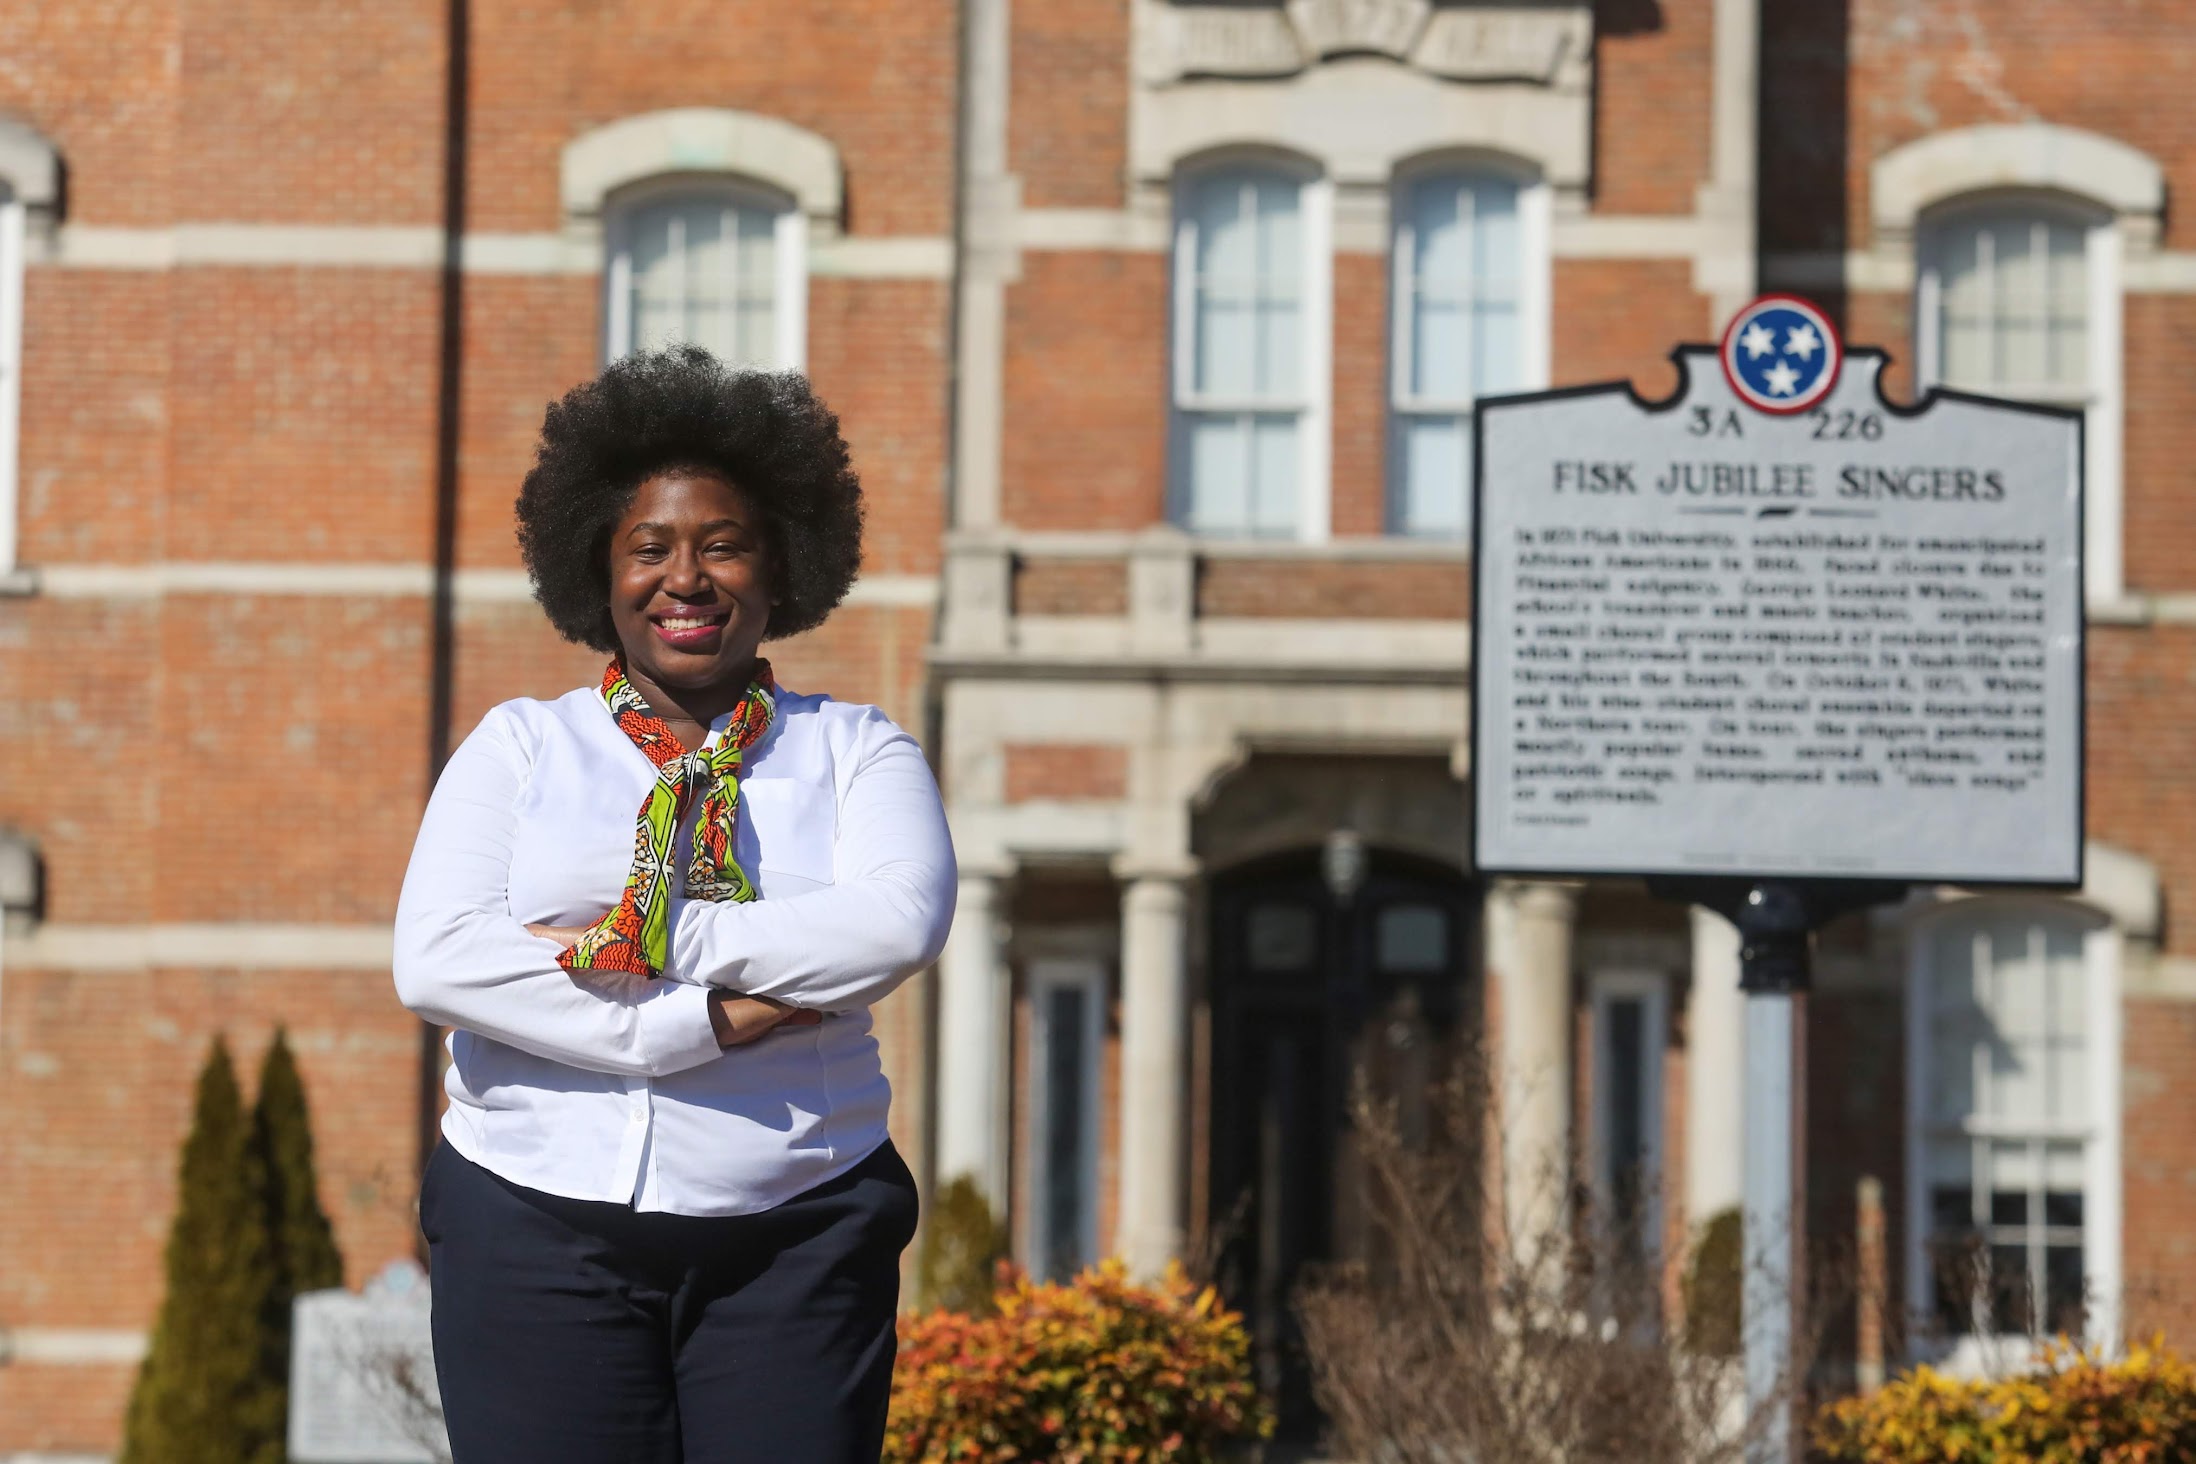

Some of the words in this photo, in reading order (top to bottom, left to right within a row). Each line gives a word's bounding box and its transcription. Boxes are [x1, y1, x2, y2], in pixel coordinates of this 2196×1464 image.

[1811, 409, 1884, 441] 226
[1553, 461, 1637, 495] FISK
[1656, 463, 1816, 498] JUBILEE
[1837, 467, 2005, 501] SINGERS
